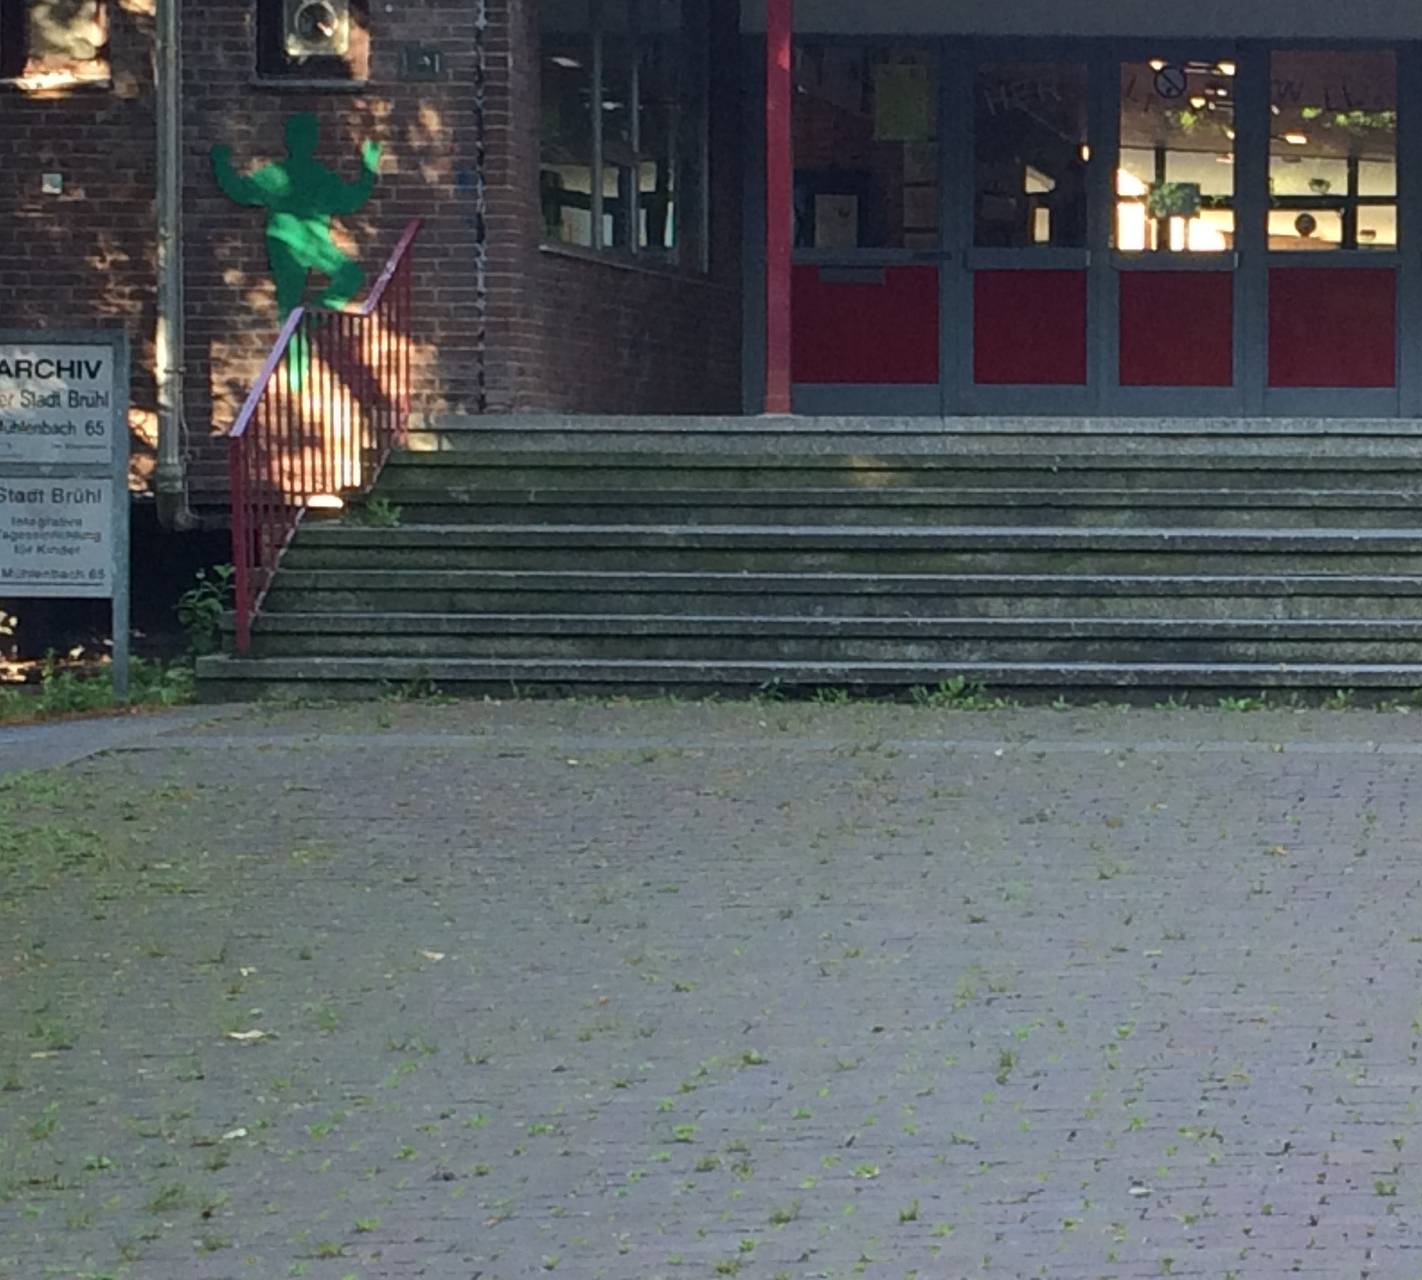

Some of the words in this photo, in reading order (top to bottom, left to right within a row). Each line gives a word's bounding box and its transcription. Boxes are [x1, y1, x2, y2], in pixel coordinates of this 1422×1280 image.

[0, 358, 102, 379] ARCHIV
[20, 388, 61, 408] Stadt
[85, 419, 105, 436] 65
[51, 487, 102, 504] Brühl
[36, 544, 81, 555] Kinder
[88, 568, 106, 580] 65
